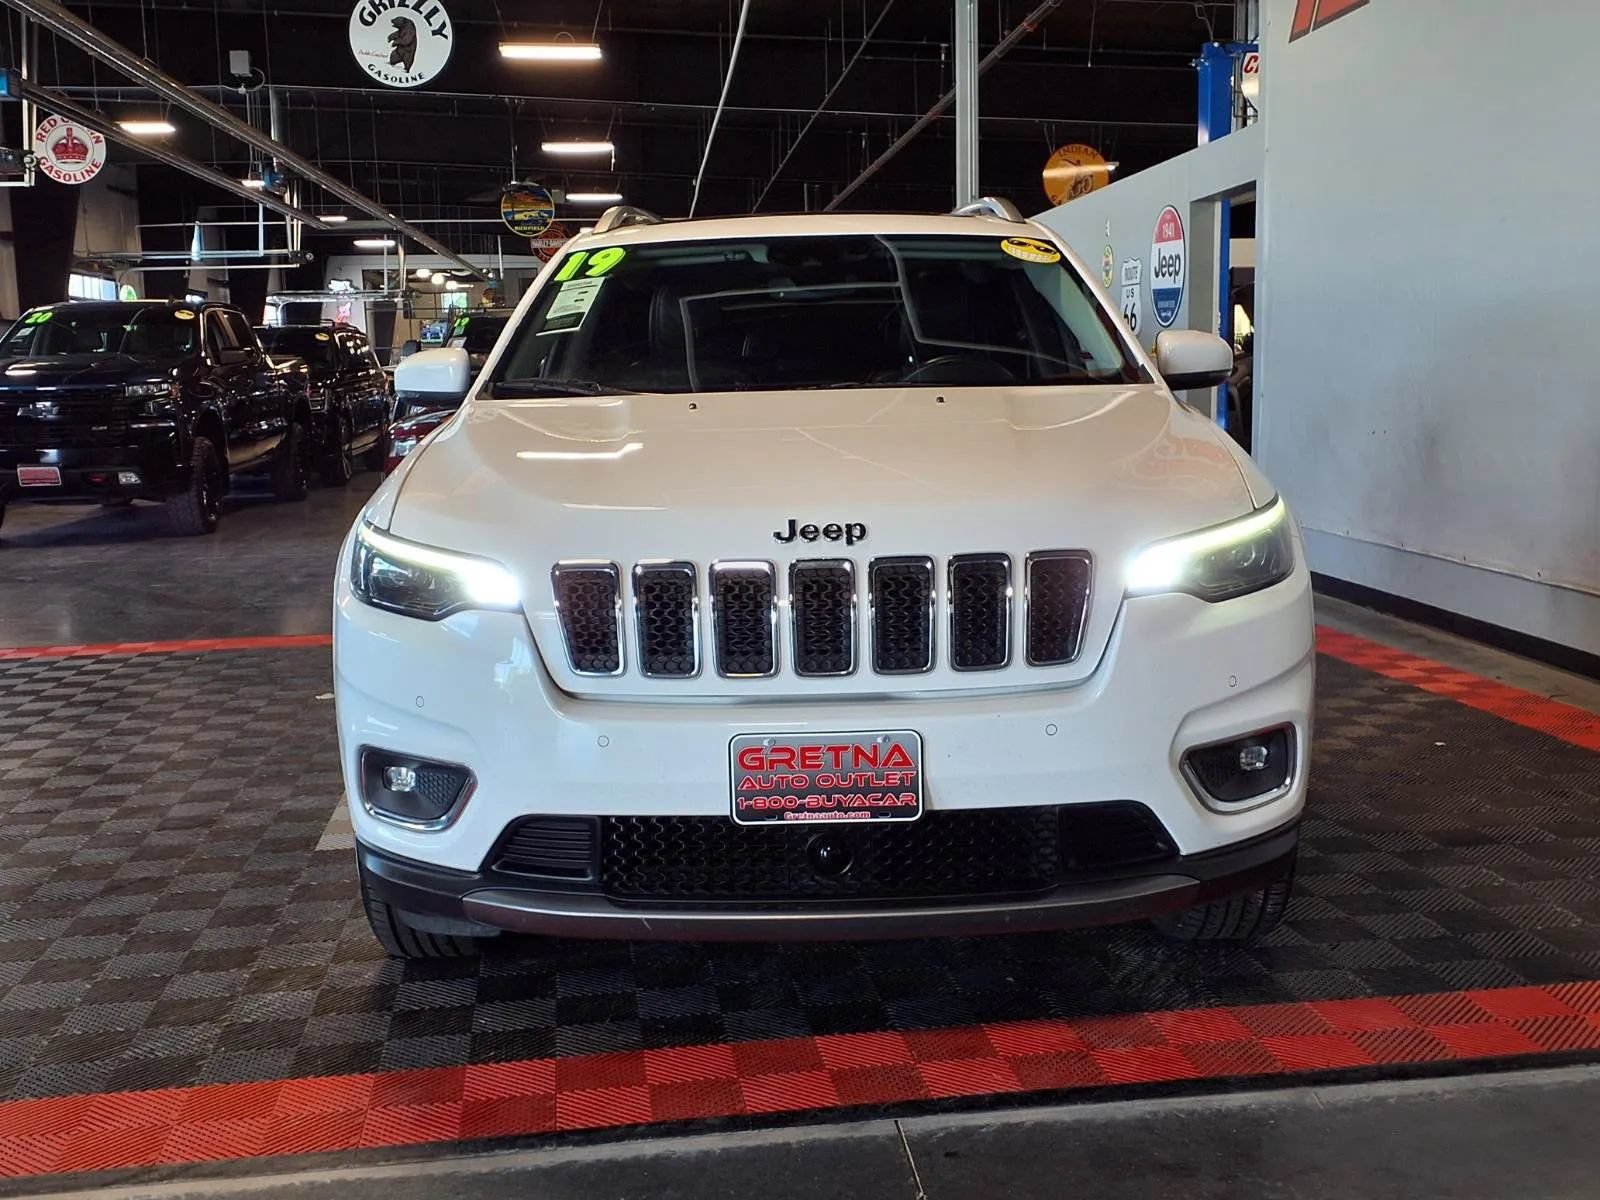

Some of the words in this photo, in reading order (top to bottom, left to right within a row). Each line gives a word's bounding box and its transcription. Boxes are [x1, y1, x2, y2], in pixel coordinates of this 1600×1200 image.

[367, 63, 425, 84] GASOLINE
[36, 117, 57, 143] RED
[38, 156, 101, 182] GASOLINE
[1162, 222, 1175, 239] 1941
[554, 247, 626, 282] 19
[1154, 247, 1181, 285] Jeep
[773, 519, 867, 546] Jeep
[737, 743, 915, 772] GRETNA
[737, 774, 809, 790] AUTO
[815, 771, 916, 788] OUTLET
[737, 793, 916, 810] 1-800-BUYACAR
